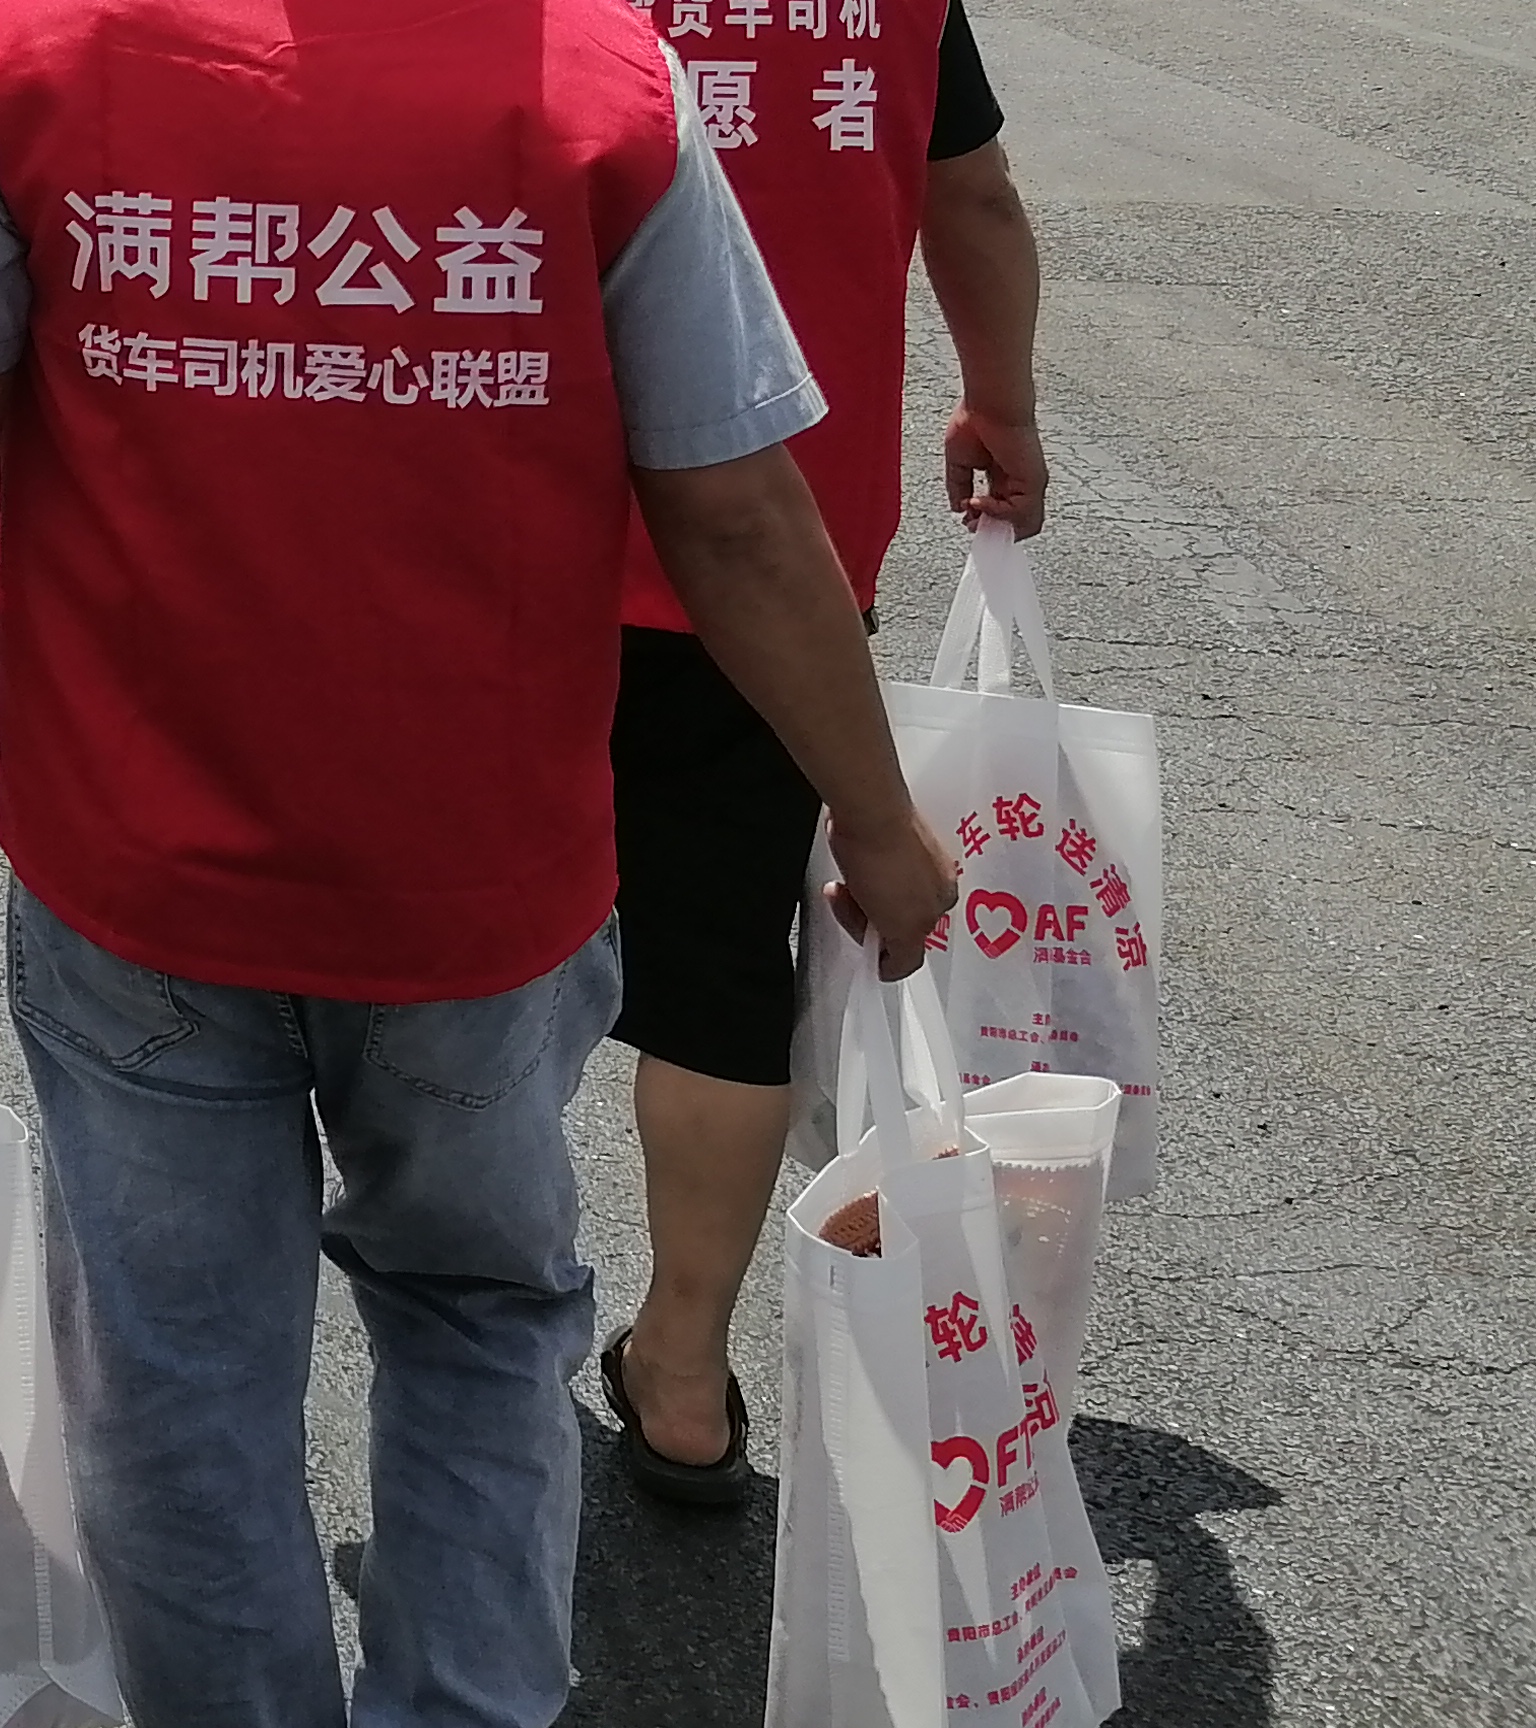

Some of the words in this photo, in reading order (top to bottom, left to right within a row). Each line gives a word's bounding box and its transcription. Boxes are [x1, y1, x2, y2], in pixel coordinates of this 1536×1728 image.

[64, 191, 544, 314] 满帮公益
[78, 323, 549, 408] 货车司机爱心联盟
